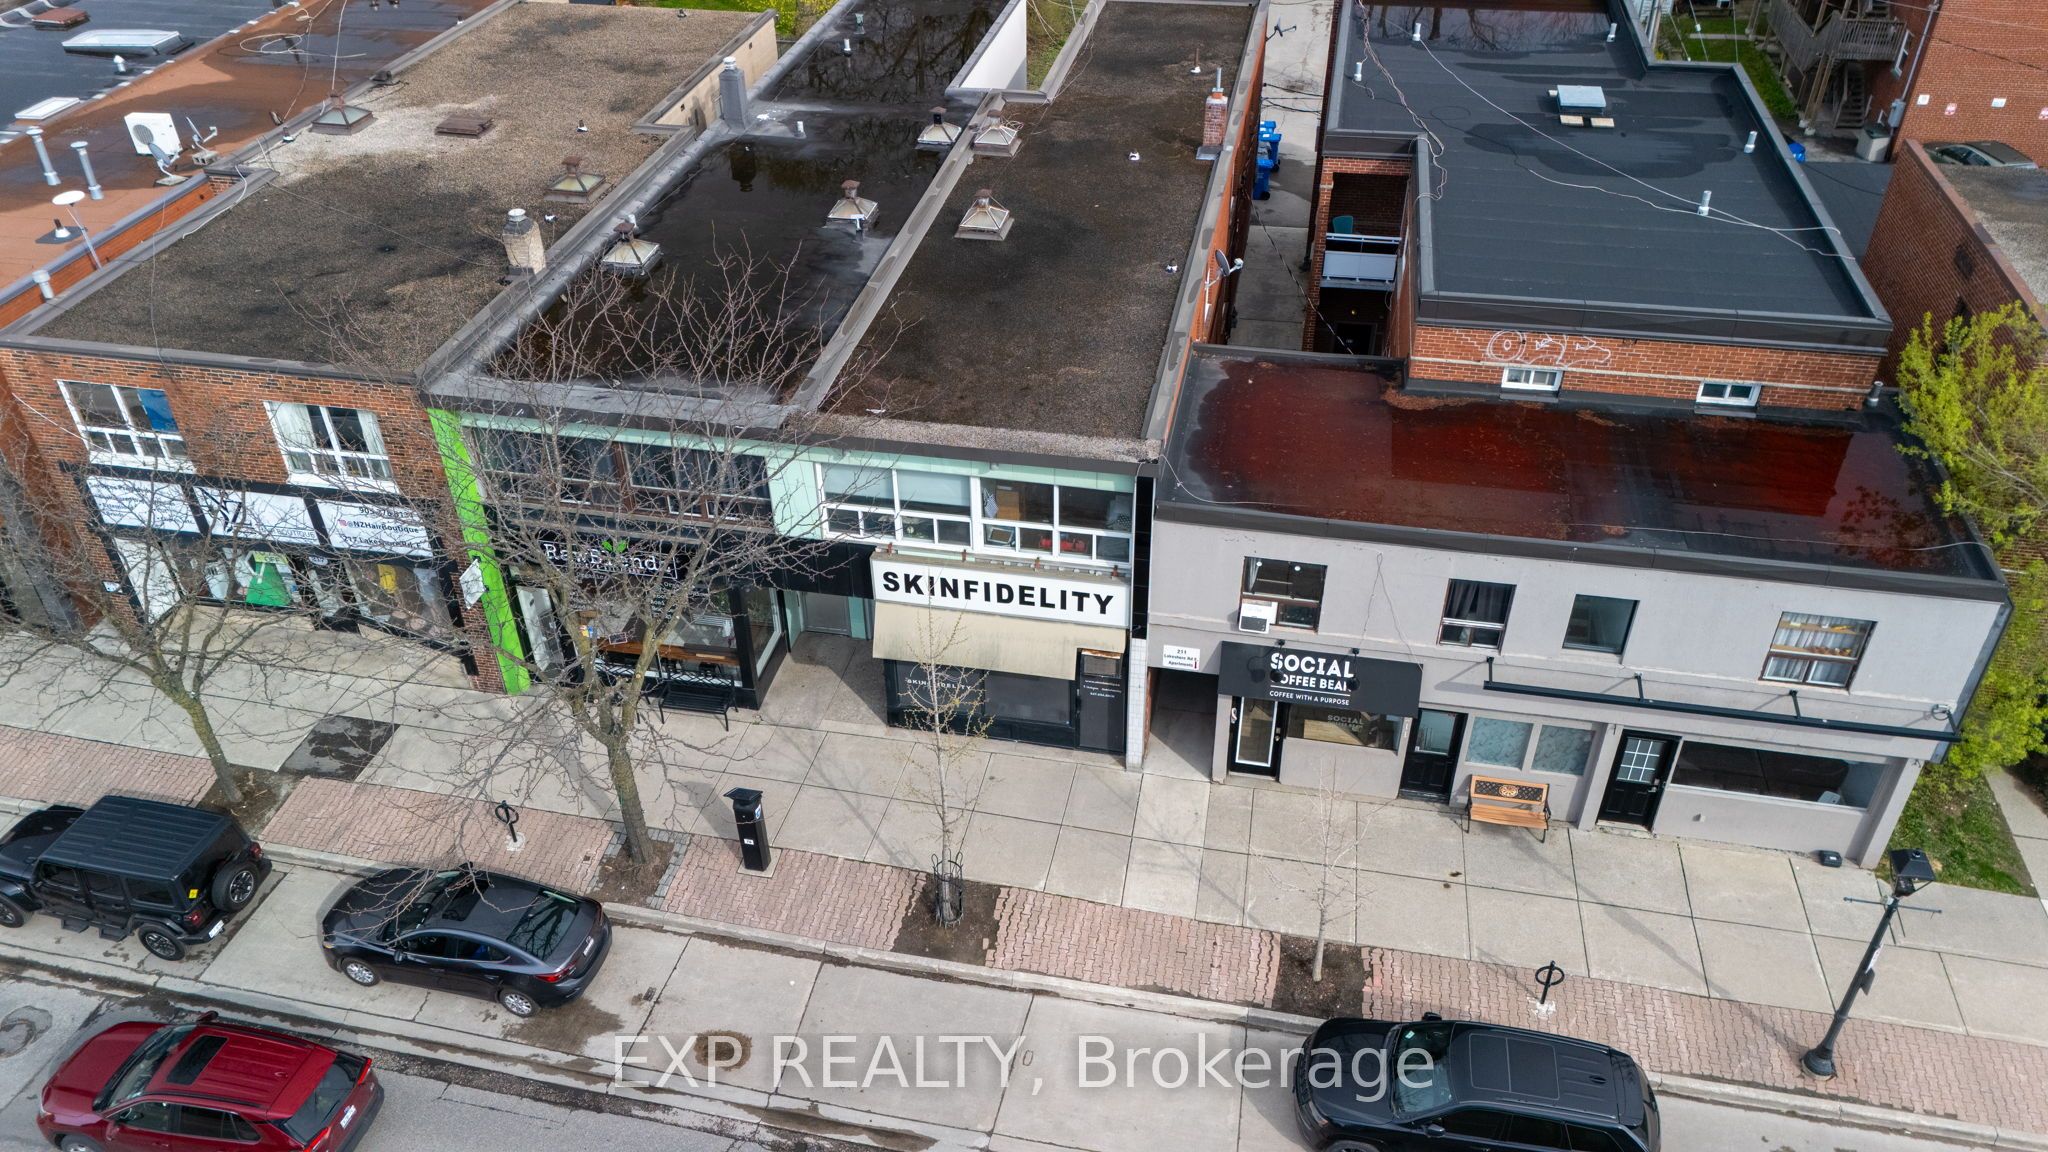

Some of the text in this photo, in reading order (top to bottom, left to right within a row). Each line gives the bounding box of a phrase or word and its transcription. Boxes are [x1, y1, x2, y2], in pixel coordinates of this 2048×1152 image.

[883, 571, 1113, 615] SKINFIDELITY
[1270, 652, 1354, 678] SOCIAL
[1272, 673, 1316, 688] OFFEE
[1269, 690, 1294, 699] COFFEE
[1295, 693, 1313, 701] WITH
[1320, 697, 1350, 706] PURPOSE
[1327, 714, 1365, 725] SOCIAL
